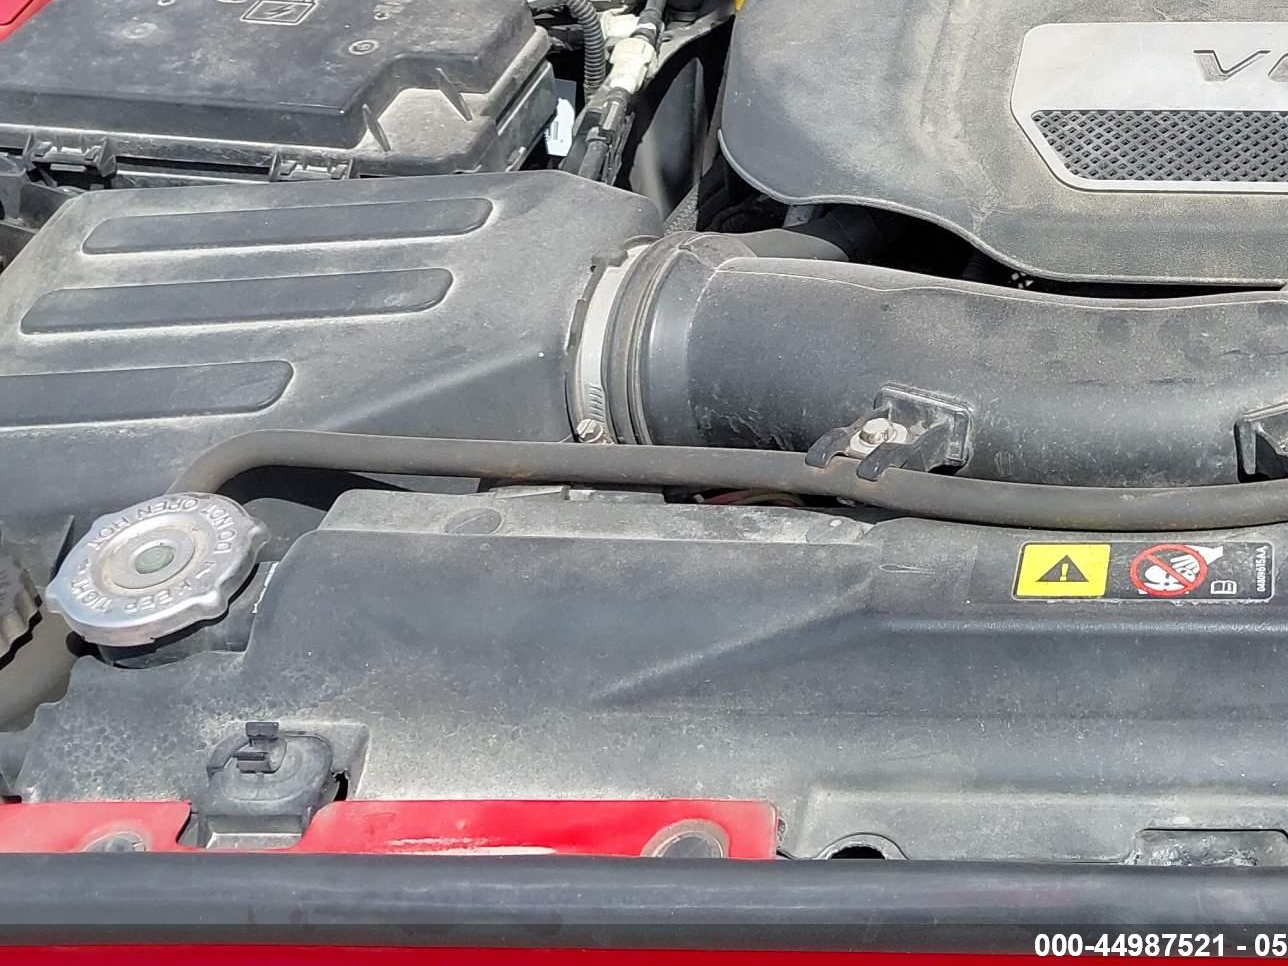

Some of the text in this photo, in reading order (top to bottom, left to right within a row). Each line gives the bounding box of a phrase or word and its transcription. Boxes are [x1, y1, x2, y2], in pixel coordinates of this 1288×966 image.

[137, 498, 199, 518] OPEN
[88, 517, 130, 550] HOT
[125, 578, 192, 612] KEEP
